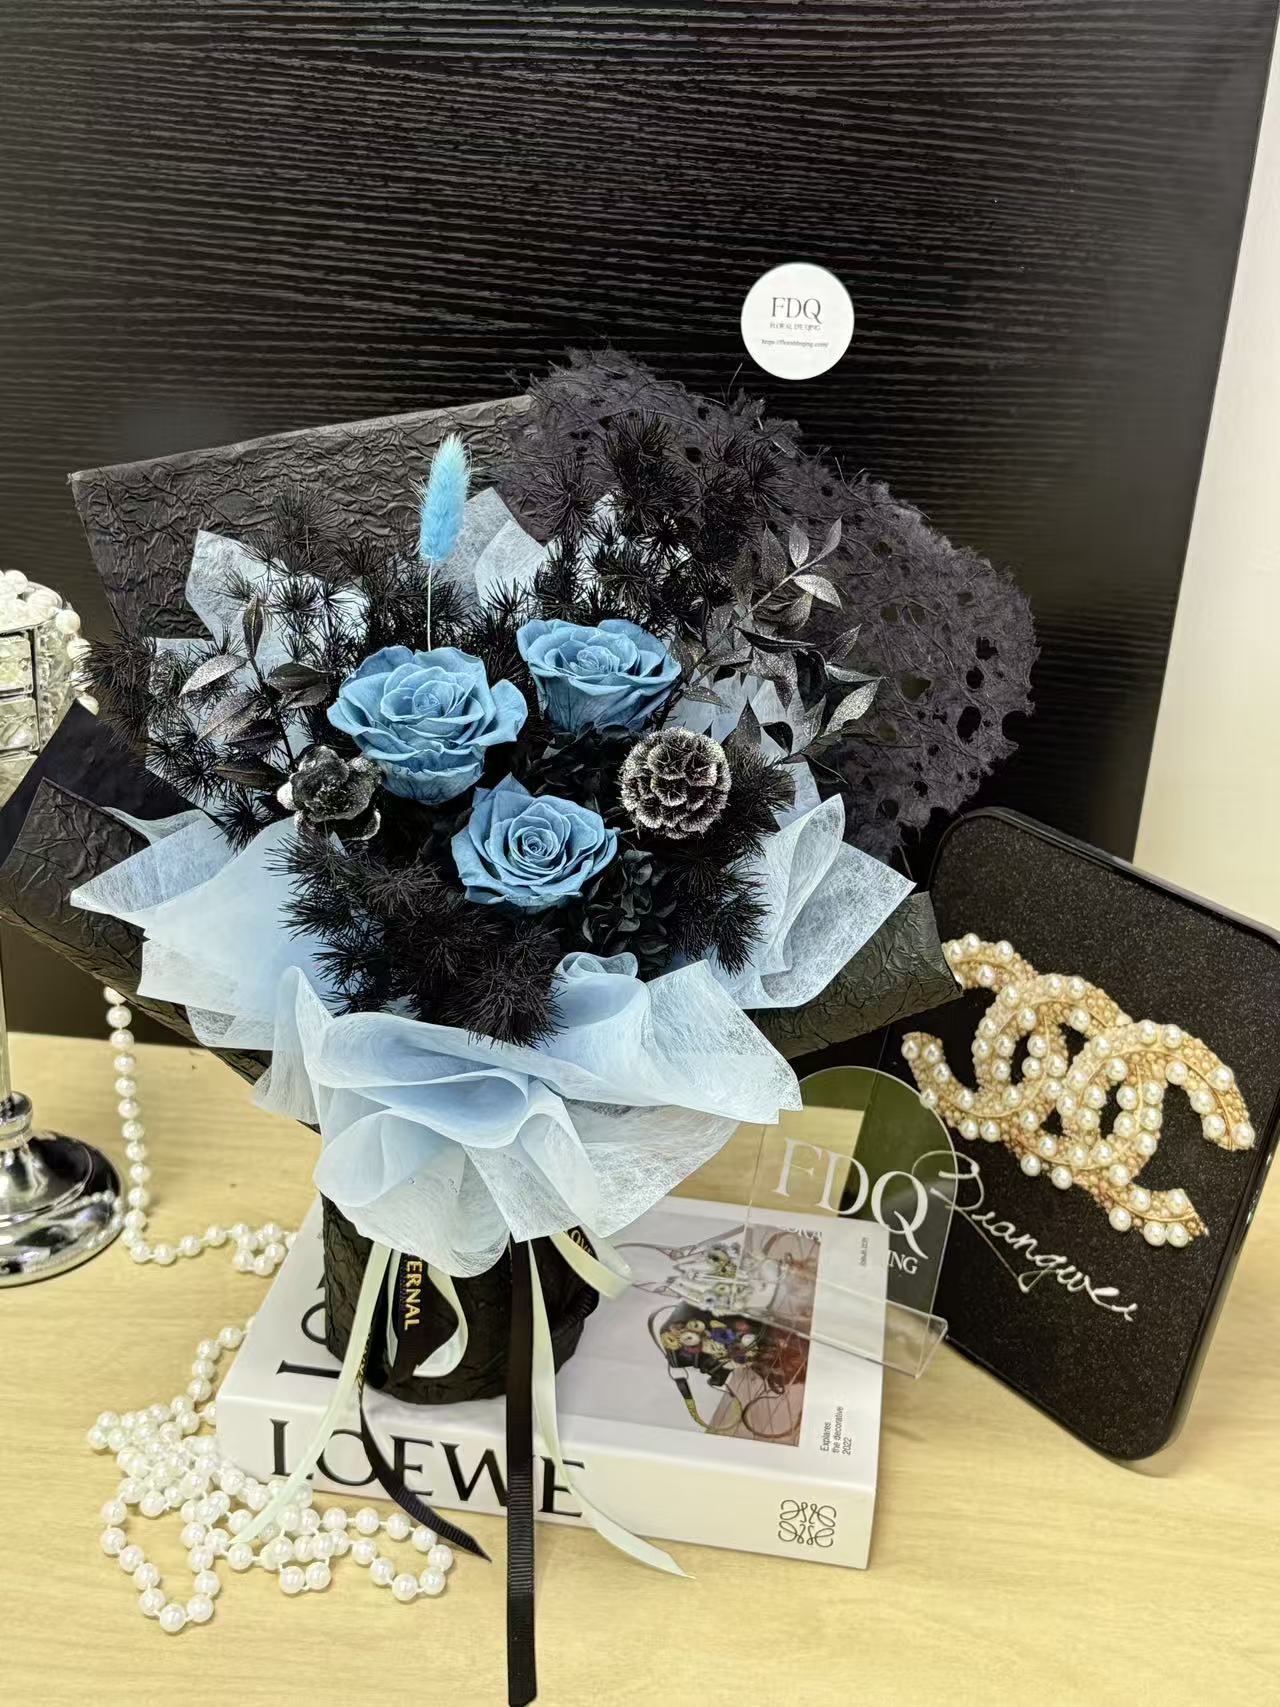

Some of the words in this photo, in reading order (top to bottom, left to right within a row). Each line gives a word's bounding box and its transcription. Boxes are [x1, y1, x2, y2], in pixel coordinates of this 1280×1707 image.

[771, 297, 822, 325] FDQ
[770, 1137, 929, 1260] FDQ
[404, 1257, 423, 1331] ERNAL
[270, 1418, 585, 1518] LOEWE
[842, 1437, 852, 1456] 2022
